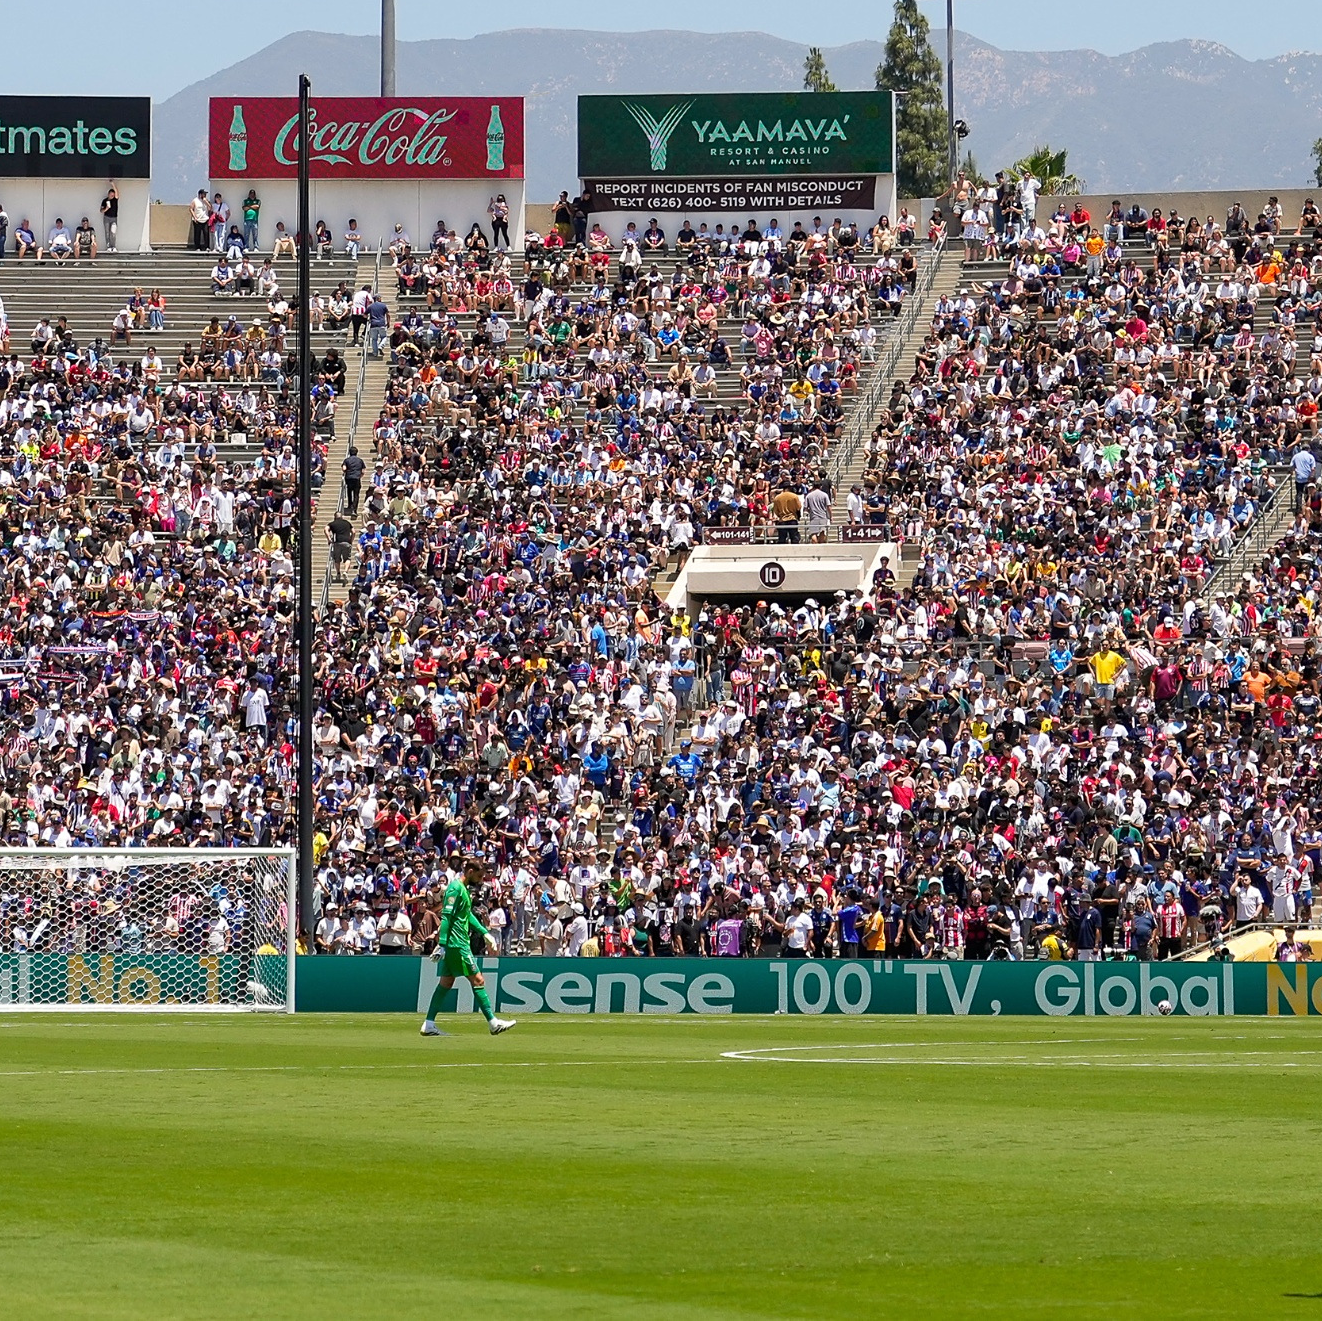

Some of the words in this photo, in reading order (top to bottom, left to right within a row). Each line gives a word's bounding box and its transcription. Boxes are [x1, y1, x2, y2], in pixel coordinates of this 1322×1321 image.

[274, 108, 459, 166] Coca-Cola
[710, 147, 760, 156] RESORT
[767, 147, 775, 155] &
[782, 146, 831, 155] CASINO
[745, 158, 766, 166] SAN
[770, 158, 812, 166] MANUEL
[595, 183, 648, 194] REPORT
[650, 182, 721, 194] INCIDENTS
[723, 182, 743, 193] OF
[745, 182, 774, 193] FAN
[776, 180, 864, 193] MISCONDUCT
[611, 197, 644, 207] TEXT
[647, 196, 682, 209] (626)
[684, 196, 717, 207] 400-
[720, 196, 746, 207] 5119
[749, 196, 784, 207] WITH
[787, 194, 843, 206] DETAILS
[721, 530, 750, 539] 101-141
[846, 527, 872, 538] 1-41
[764, 567, 780, 583] 10
[67, 954, 183, 1006] No.
[769, 959, 892, 1016] 100"
[902, 963, 1001, 1016] TV,
[1034, 963, 1234, 1016] Global
